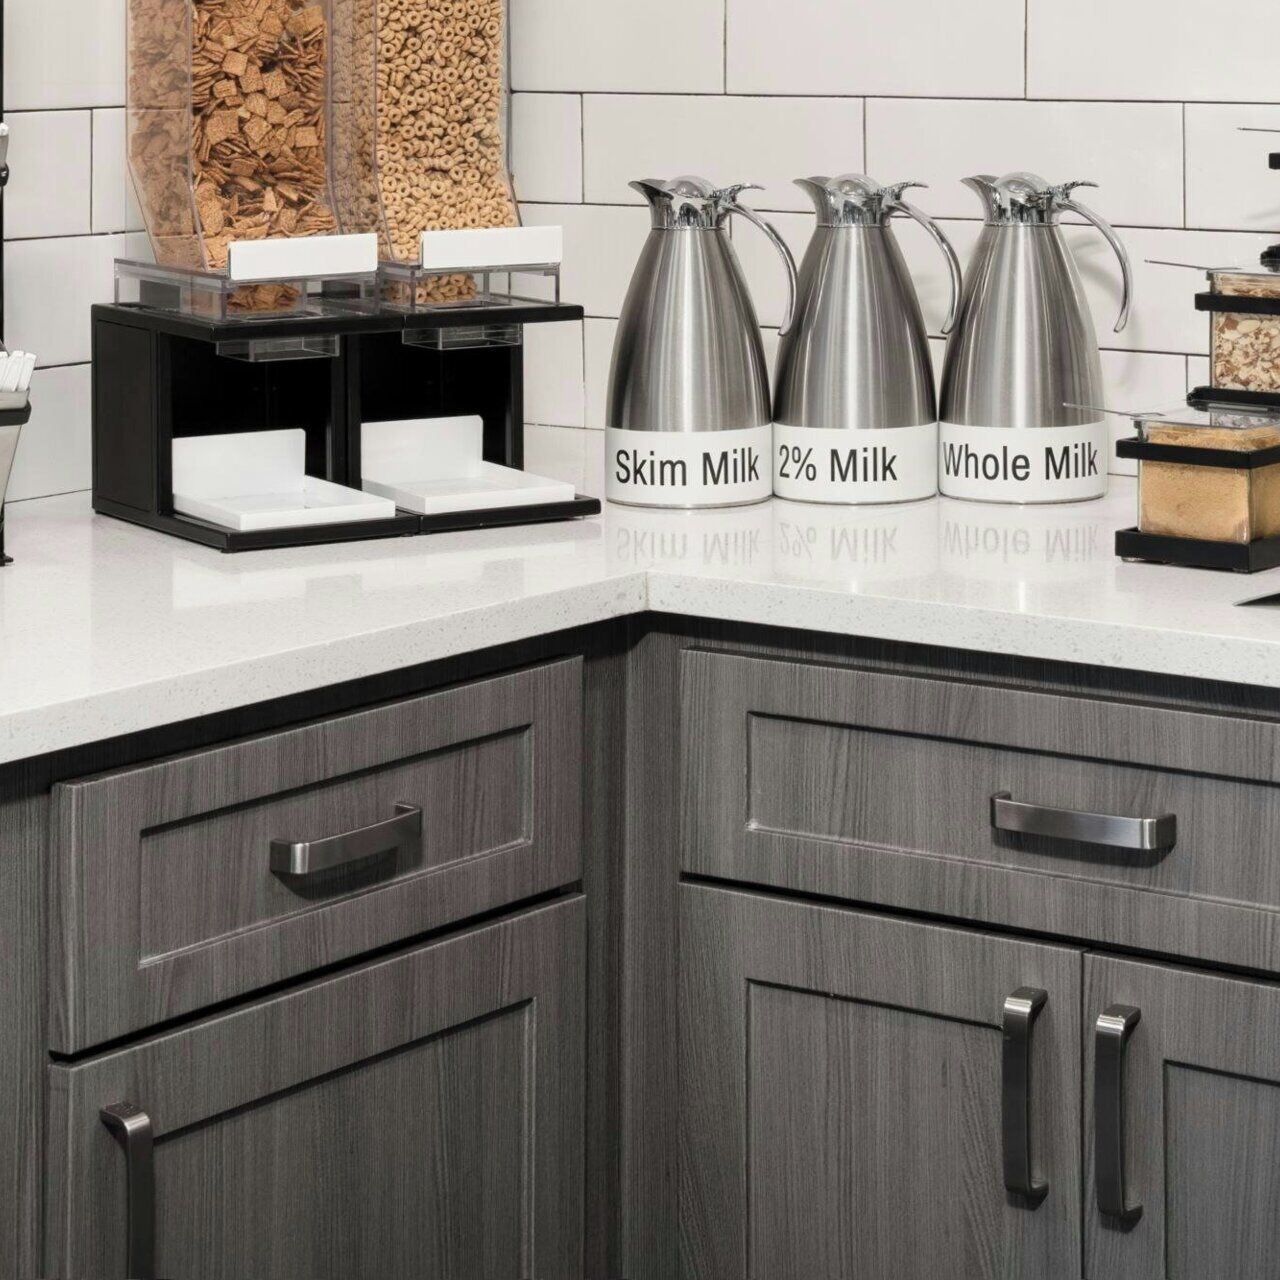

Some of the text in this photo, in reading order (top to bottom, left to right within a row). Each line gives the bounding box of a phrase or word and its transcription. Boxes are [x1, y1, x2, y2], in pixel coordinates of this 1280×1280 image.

[615, 446, 760, 486] Skim Milk
[779, 444, 898, 482] 2% Milk
[943, 441, 1098, 481] Whole Milk
